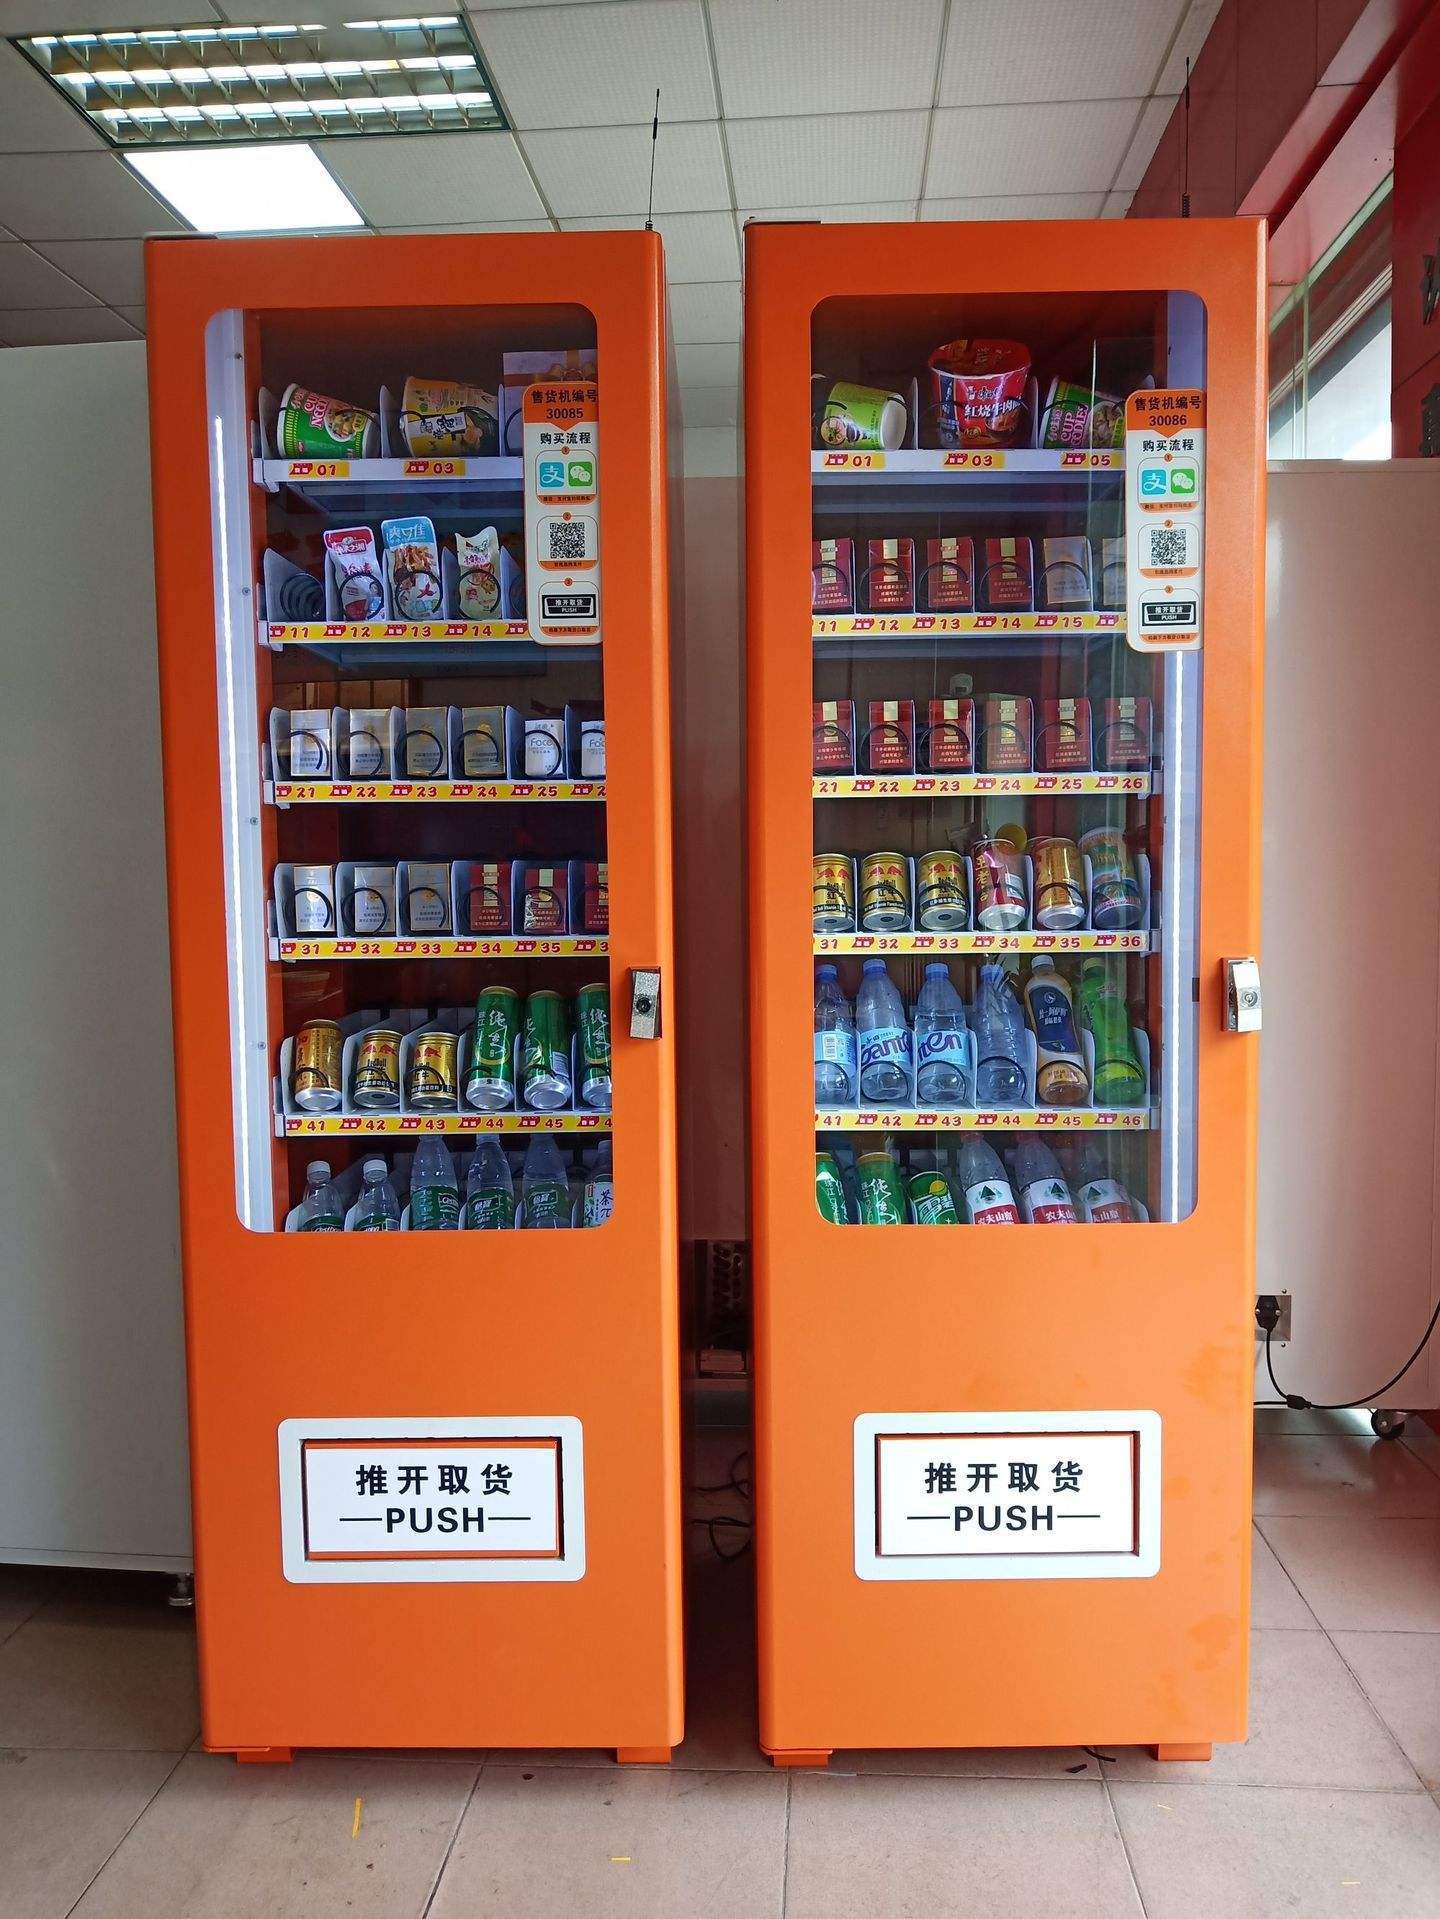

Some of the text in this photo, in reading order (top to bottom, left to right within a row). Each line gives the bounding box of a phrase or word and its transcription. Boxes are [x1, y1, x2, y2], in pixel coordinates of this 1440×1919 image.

[531, 389, 597, 404] 售货机编号
[1135, 395, 1202, 411] 售货机编号
[546, 408, 583, 419] 30085
[1149, 415, 1187, 426] 30086
[540, 432, 591, 444] 购买流程
[1142, 439, 1194, 452] 购买流程
[852, 456, 872, 466] 01
[972, 455, 993, 466] 03
[1091, 455, 1111, 466] 05
[317, 465, 336, 475] 01
[434, 463, 454, 474] 03
[818, 620, 836, 631] 11
[879, 619, 899, 631] 12
[940, 619, 960, 630] 13
[1001, 617, 1021, 628] 14
[1063, 616, 1083, 627] 15
[290, 627, 309, 638] 11
[350, 626, 371, 638] 12
[411, 626, 431, 637] 13
[472, 625, 492, 636] 14
[819, 781, 837, 793] 21
[879, 781, 899, 792] 22
[939, 781, 960, 792] 23
[1001, 779, 1021, 791] 24
[1061, 779, 1082, 790] 25
[1122, 778, 1143, 789] 26
[297, 787, 315, 798] 21
[356, 786, 376, 798] 22
[417, 786, 437, 798] 23
[477, 786, 497, 797] 24
[537, 786, 557, 797] 25
[597, 786, 606, 796] 2
[599, 942, 608, 952] 3
[820, 938, 838, 949] 31
[879, 938, 899, 949] 32
[939, 938, 959, 949] 33
[998, 938, 1020, 949] 34
[1060, 937, 1080, 948] 35
[1120, 936, 1141, 947] 36
[301, 943, 320, 955] 31
[360, 943, 381, 954] 32
[421, 943, 441, 954] 33
[481, 942, 502, 954] 34
[540, 942, 561, 953] 35
[307, 1120, 325, 1131] 41
[365, 1119, 386, 1131] 42
[425, 1119, 445, 1130] 43
[485, 1118, 504, 1129] 44
[545, 1118, 563, 1128] 45
[823, 1115, 841, 1126] 41
[882, 1115, 901, 1126] 42
[941, 1115, 961, 1126] 43
[1002, 1115, 1021, 1125] 44
[1062, 1116, 1081, 1126] 45
[1122, 1115, 1141, 1126] 46
[355, 1463, 513, 1496] 推开取货
[924, 1461, 1083, 1494] 推开取货
[386, 1507, 485, 1534] PUSH
[954, 1505, 1053, 1532] PUSH
